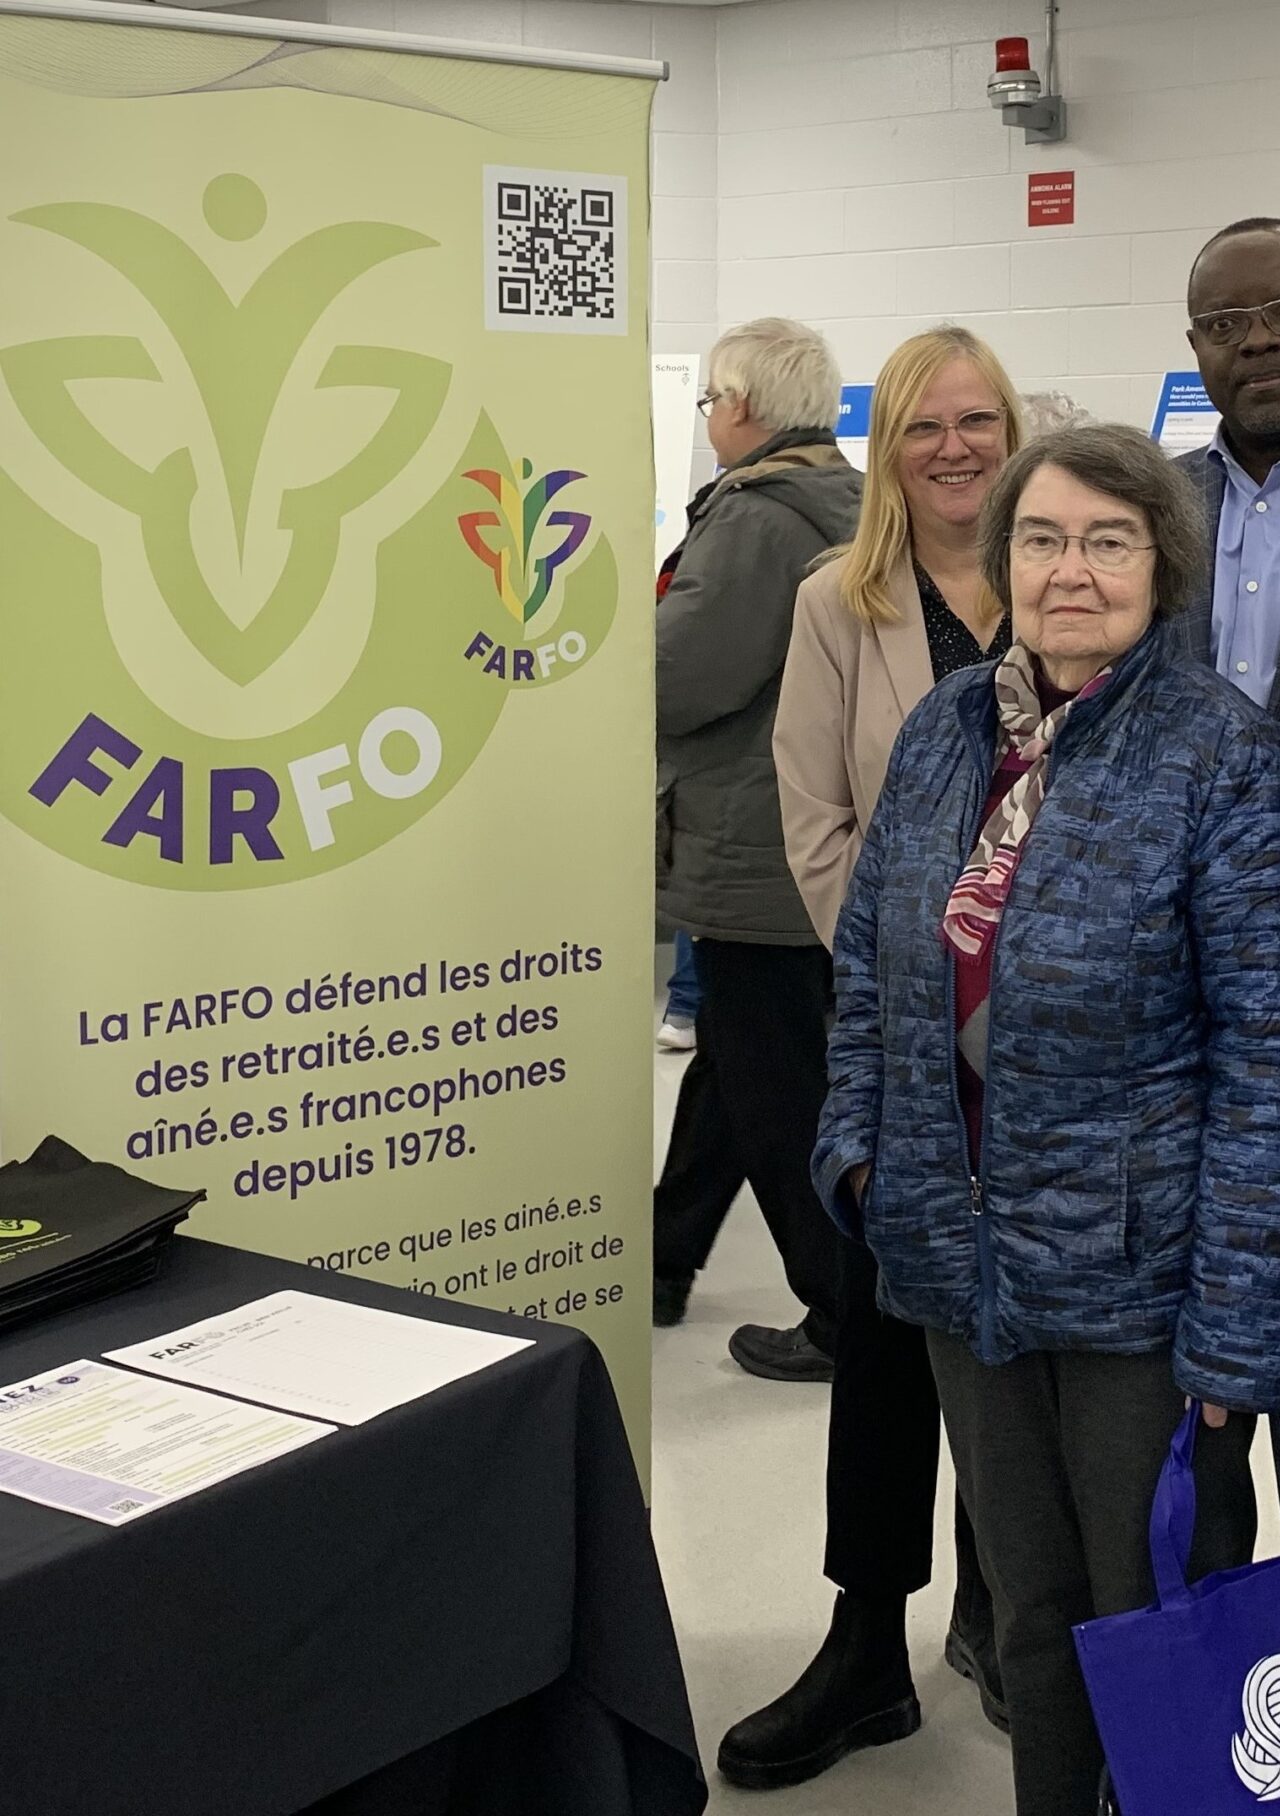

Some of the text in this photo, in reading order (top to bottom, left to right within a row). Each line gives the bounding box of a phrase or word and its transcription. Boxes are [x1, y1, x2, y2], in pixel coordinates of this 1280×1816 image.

[655, 364, 690, 372] Schools
[464, 631, 587, 681] FARFO
[27, 706, 442, 866] FARFO
[79, 942, 603, 1046] La FARFO défend les droits
[135, 1004, 559, 1098] des retraité.e.s et des
[126, 1057, 567, 1161] aîné.e.s francophones
[233, 1124, 477, 1200] depuis 1978.
[399, 1228, 453, 1262] que
[461, 1216, 497, 1243] les
[504, 1194, 602, 1232] ainé.e.s
[444, 1264, 488, 1296] ont
[496, 1259, 518, 1283] le
[525, 1241, 584, 1276] droit
[591, 1234, 624, 1260] de
[523, 1297, 548, 1320] et
[554, 1289, 588, 1315] de
[594, 1283, 624, 1306] se
[149, 1330, 226, 1360] FARFO
